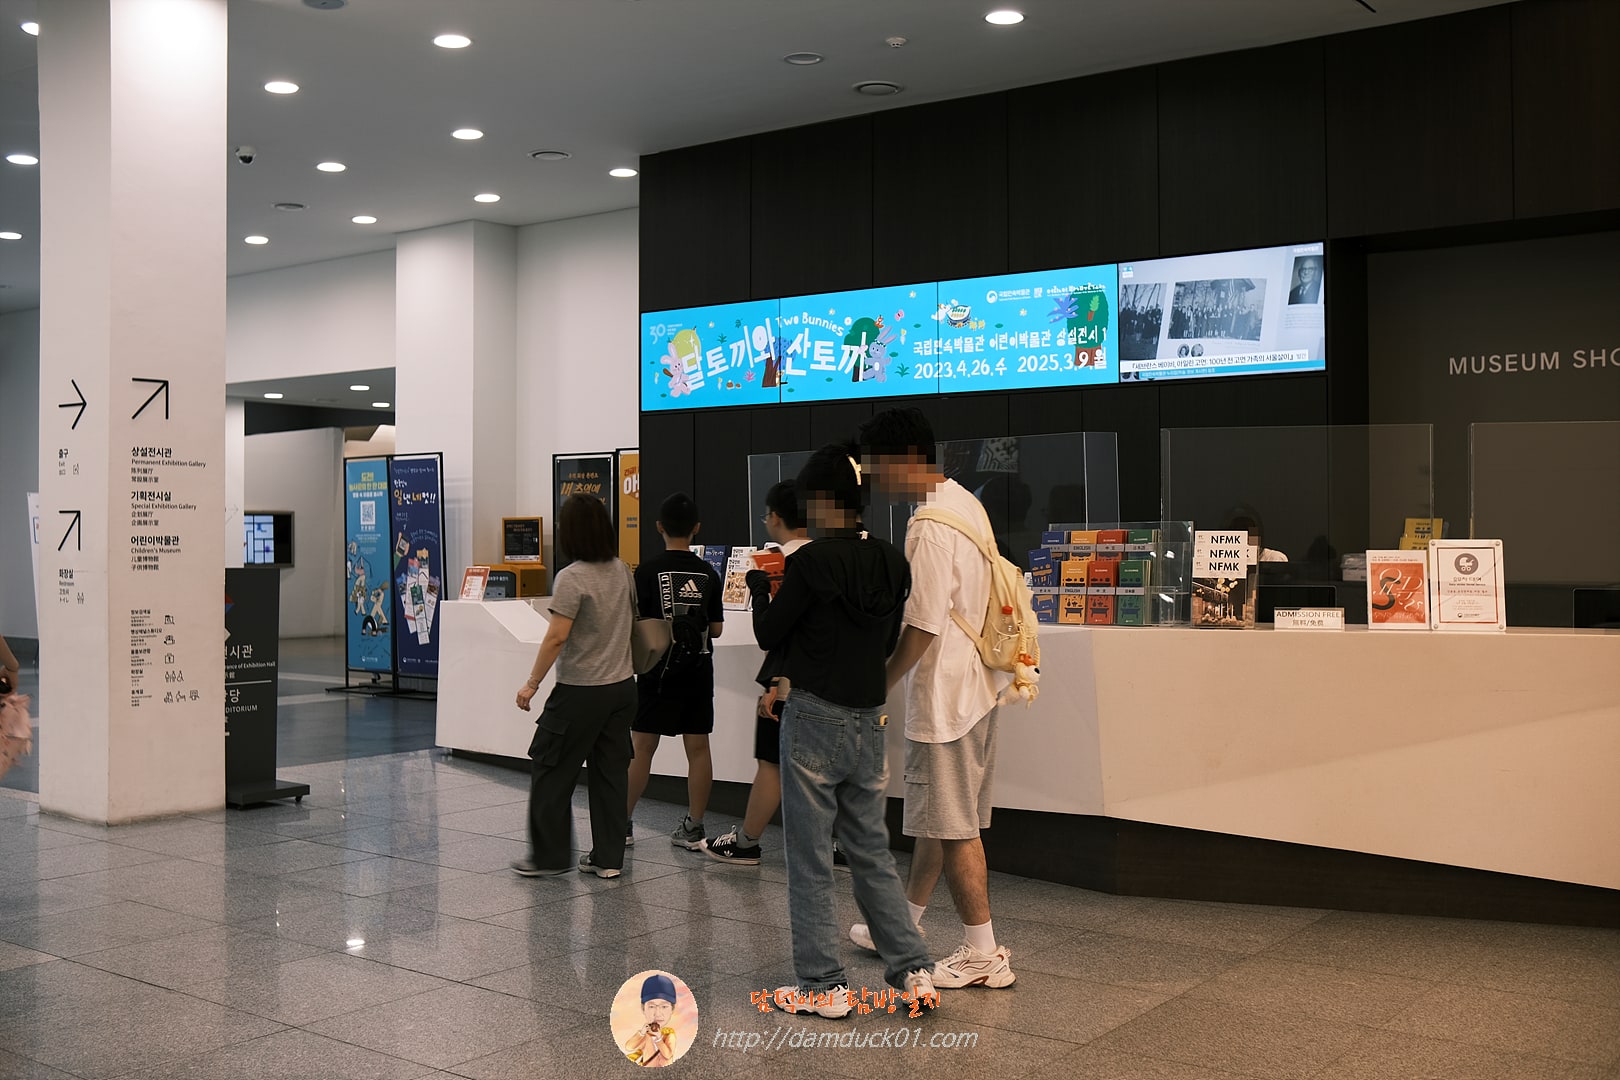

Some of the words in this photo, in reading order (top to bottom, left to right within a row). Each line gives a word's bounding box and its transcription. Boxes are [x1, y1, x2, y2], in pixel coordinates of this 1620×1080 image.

[775, 315, 799, 328] Two
[802, 312, 844, 337] Bunnies
[650, 324, 666, 344] 30
[913, 335, 985, 356] 국립민속박물관
[989, 329, 1051, 351] 어린이박물관
[1056, 324, 1098, 346] 상설전시
[1102, 327, 1107, 341] 1
[785, 327, 868, 382] 산토끼
[1449, 352, 1560, 376] MUSEUM
[131, 446, 172, 458] 상설전시관
[131, 490, 172, 502] 기획전시실
[130, 535, 180, 546] 어린이박물관
[1211, 535, 1241, 544] NFMK
[1210, 549, 1240, 559] NFMK
[1209, 562, 1240, 571] NFMK
[59, 568, 74, 579] 화장실
[661, 574, 672, 610] WORLD
